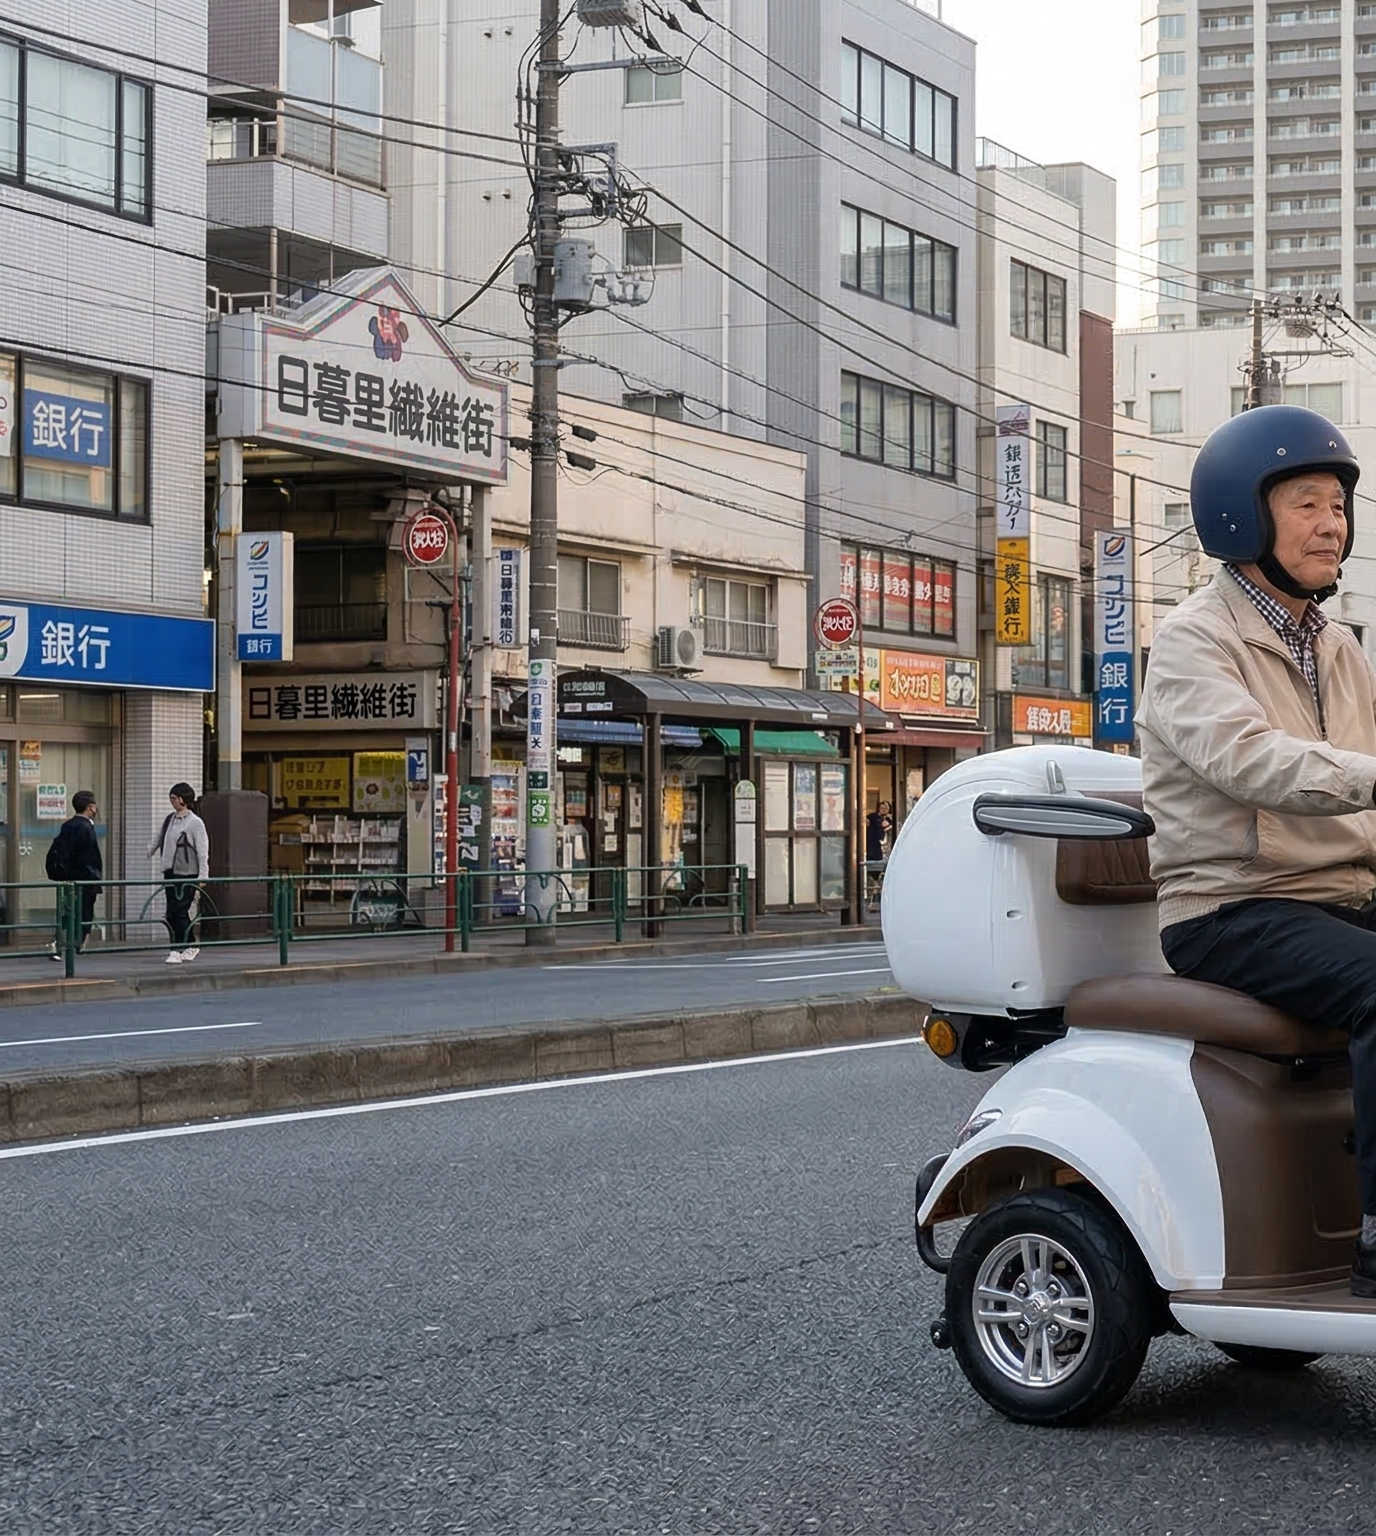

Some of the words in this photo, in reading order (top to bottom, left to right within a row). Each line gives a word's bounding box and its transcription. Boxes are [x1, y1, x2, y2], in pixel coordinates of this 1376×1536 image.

[33, 400, 104, 456] 銀行
[278, 354, 494, 458] 日暮里繊維街
[41, 620, 111, 669] 銀行
[249, 682, 417, 720] 日暮里繊維街
